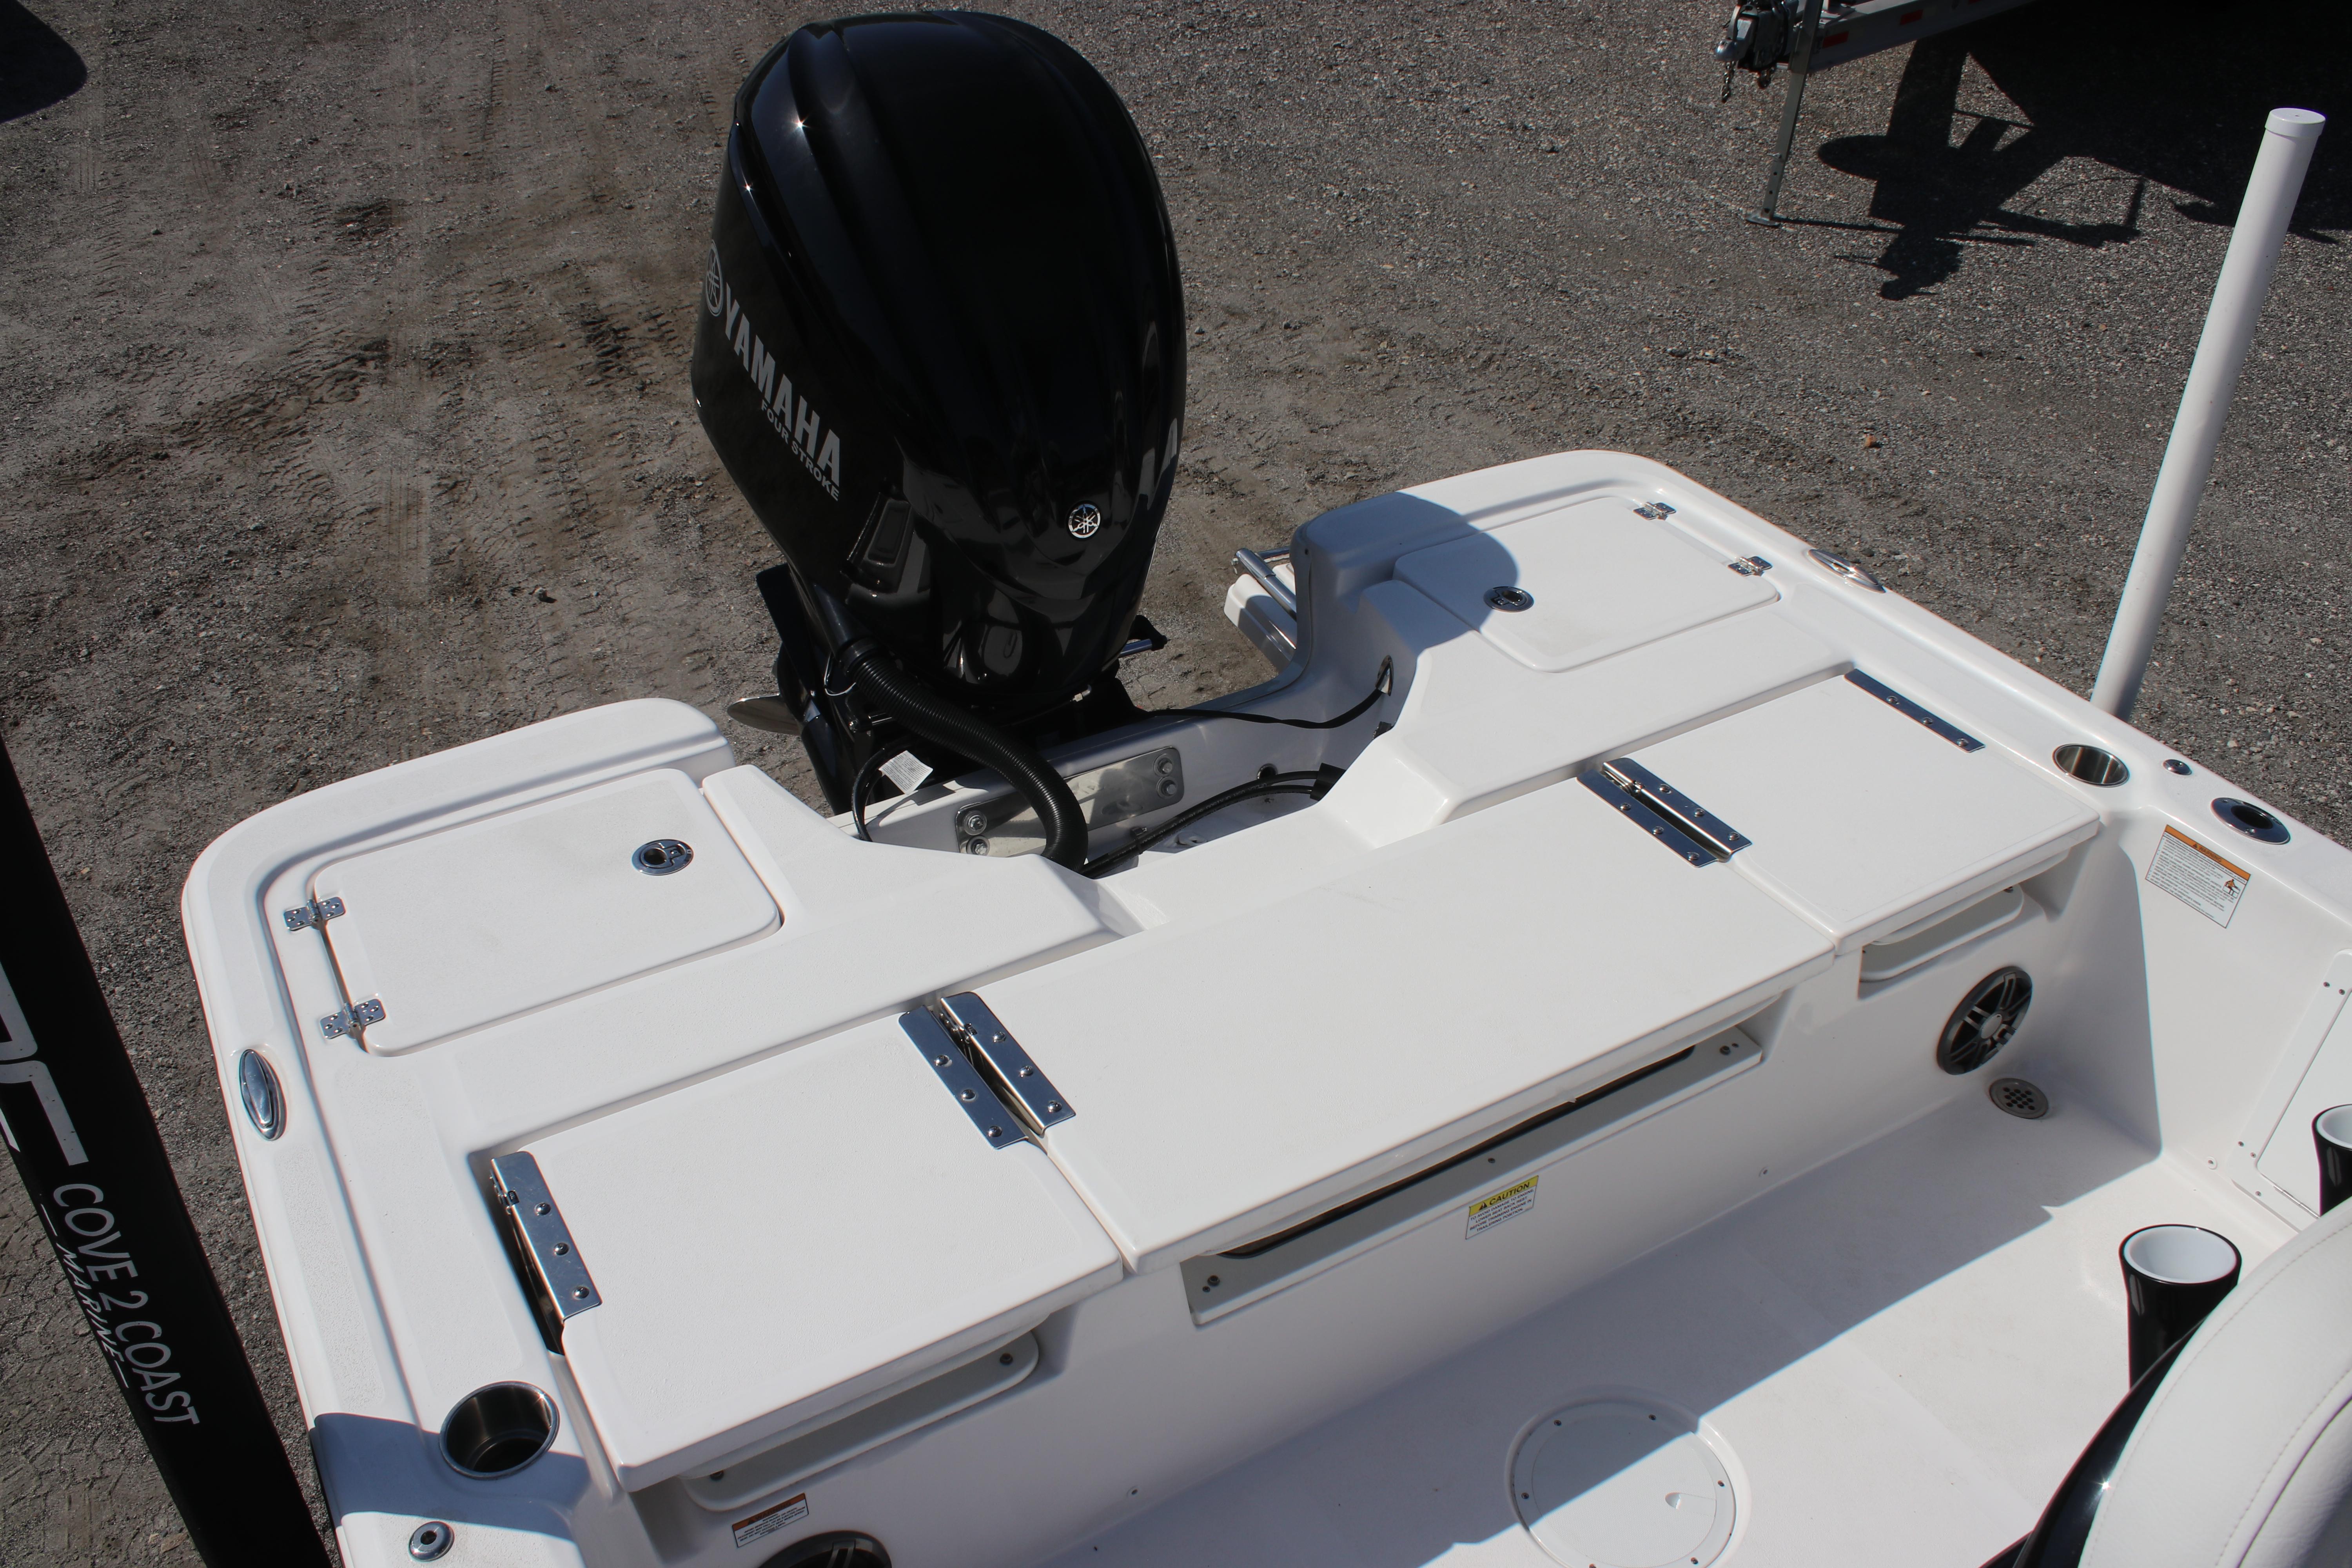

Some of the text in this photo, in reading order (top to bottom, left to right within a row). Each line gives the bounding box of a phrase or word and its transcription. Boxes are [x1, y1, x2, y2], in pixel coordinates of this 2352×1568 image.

[725, 282, 840, 487] YAMAHA
[761, 399, 839, 501] FOUR STROKE
[1489, 1181, 1530, 1205] CAUTION
[53, 1183, 200, 1424] COVE 2 COAST
[56, 1242, 125, 1362] MARINE
